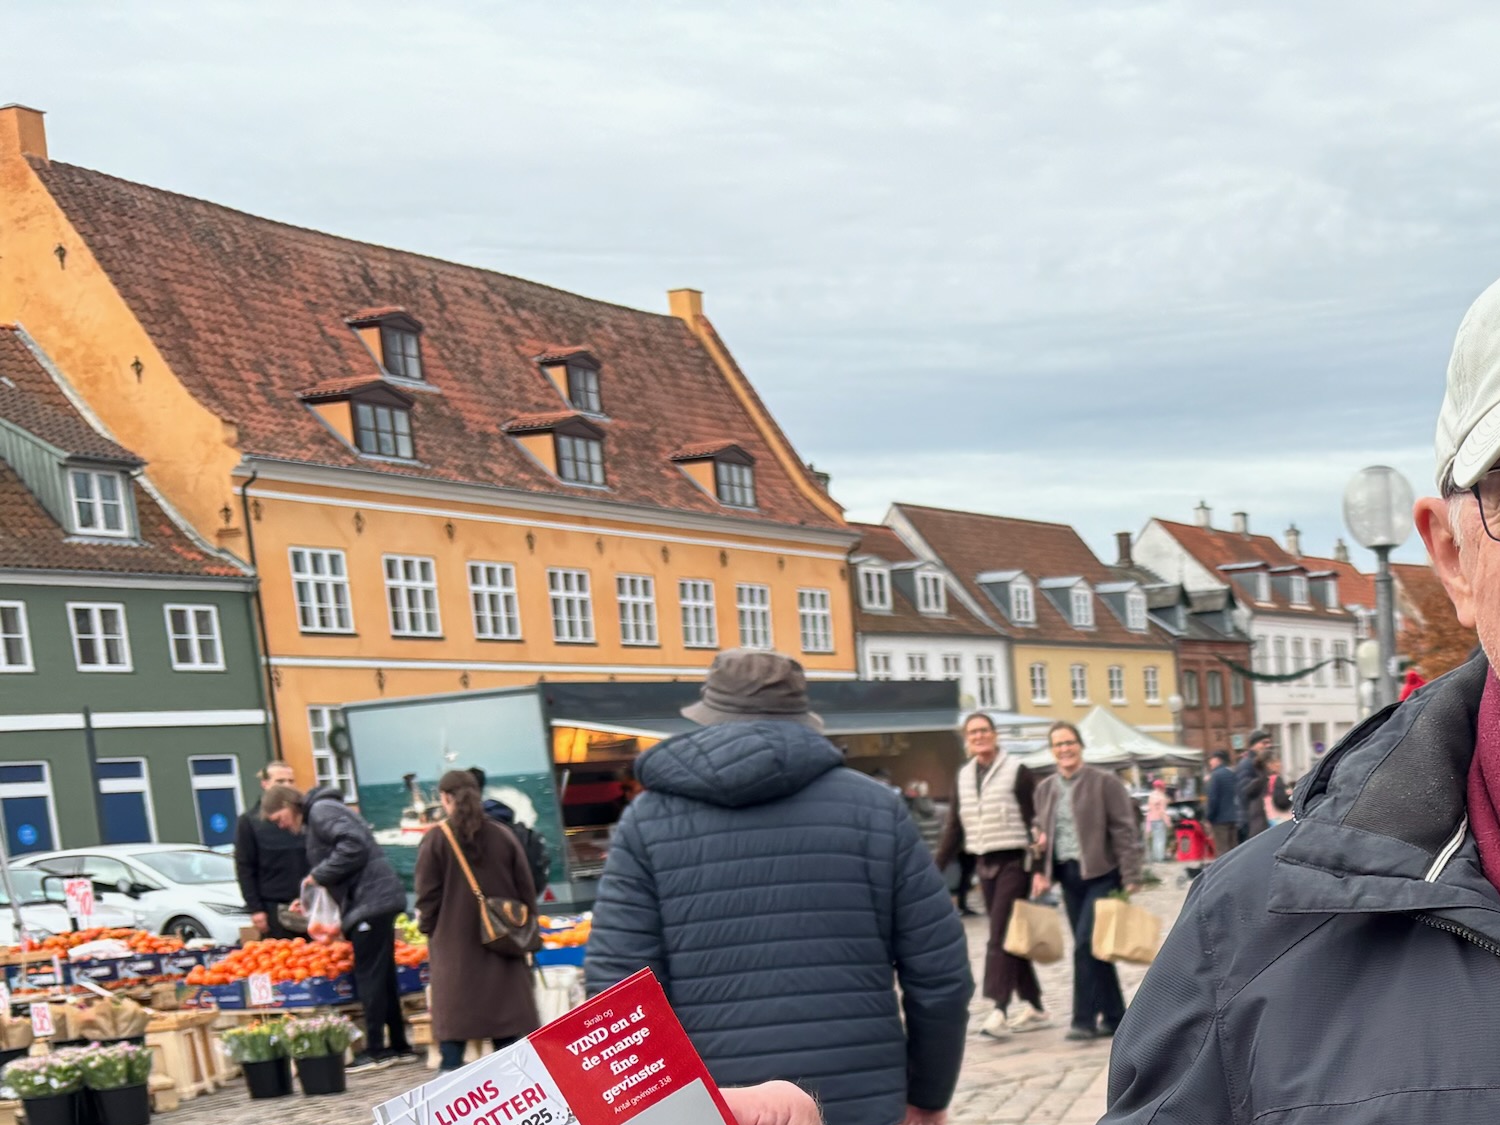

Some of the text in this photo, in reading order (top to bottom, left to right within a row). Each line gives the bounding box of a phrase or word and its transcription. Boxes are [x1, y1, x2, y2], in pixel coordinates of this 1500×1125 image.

[565, 1005, 646, 1056] VIND en af
[584, 1008, 614, 1029] Skrab og
[581, 1027, 651, 1071] de mange
[609, 1054, 639, 1076] fine
[602, 1058, 666, 1104] gevinster
[613, 1099, 632, 1115] Antal
[658, 1075, 673, 1089] 338
